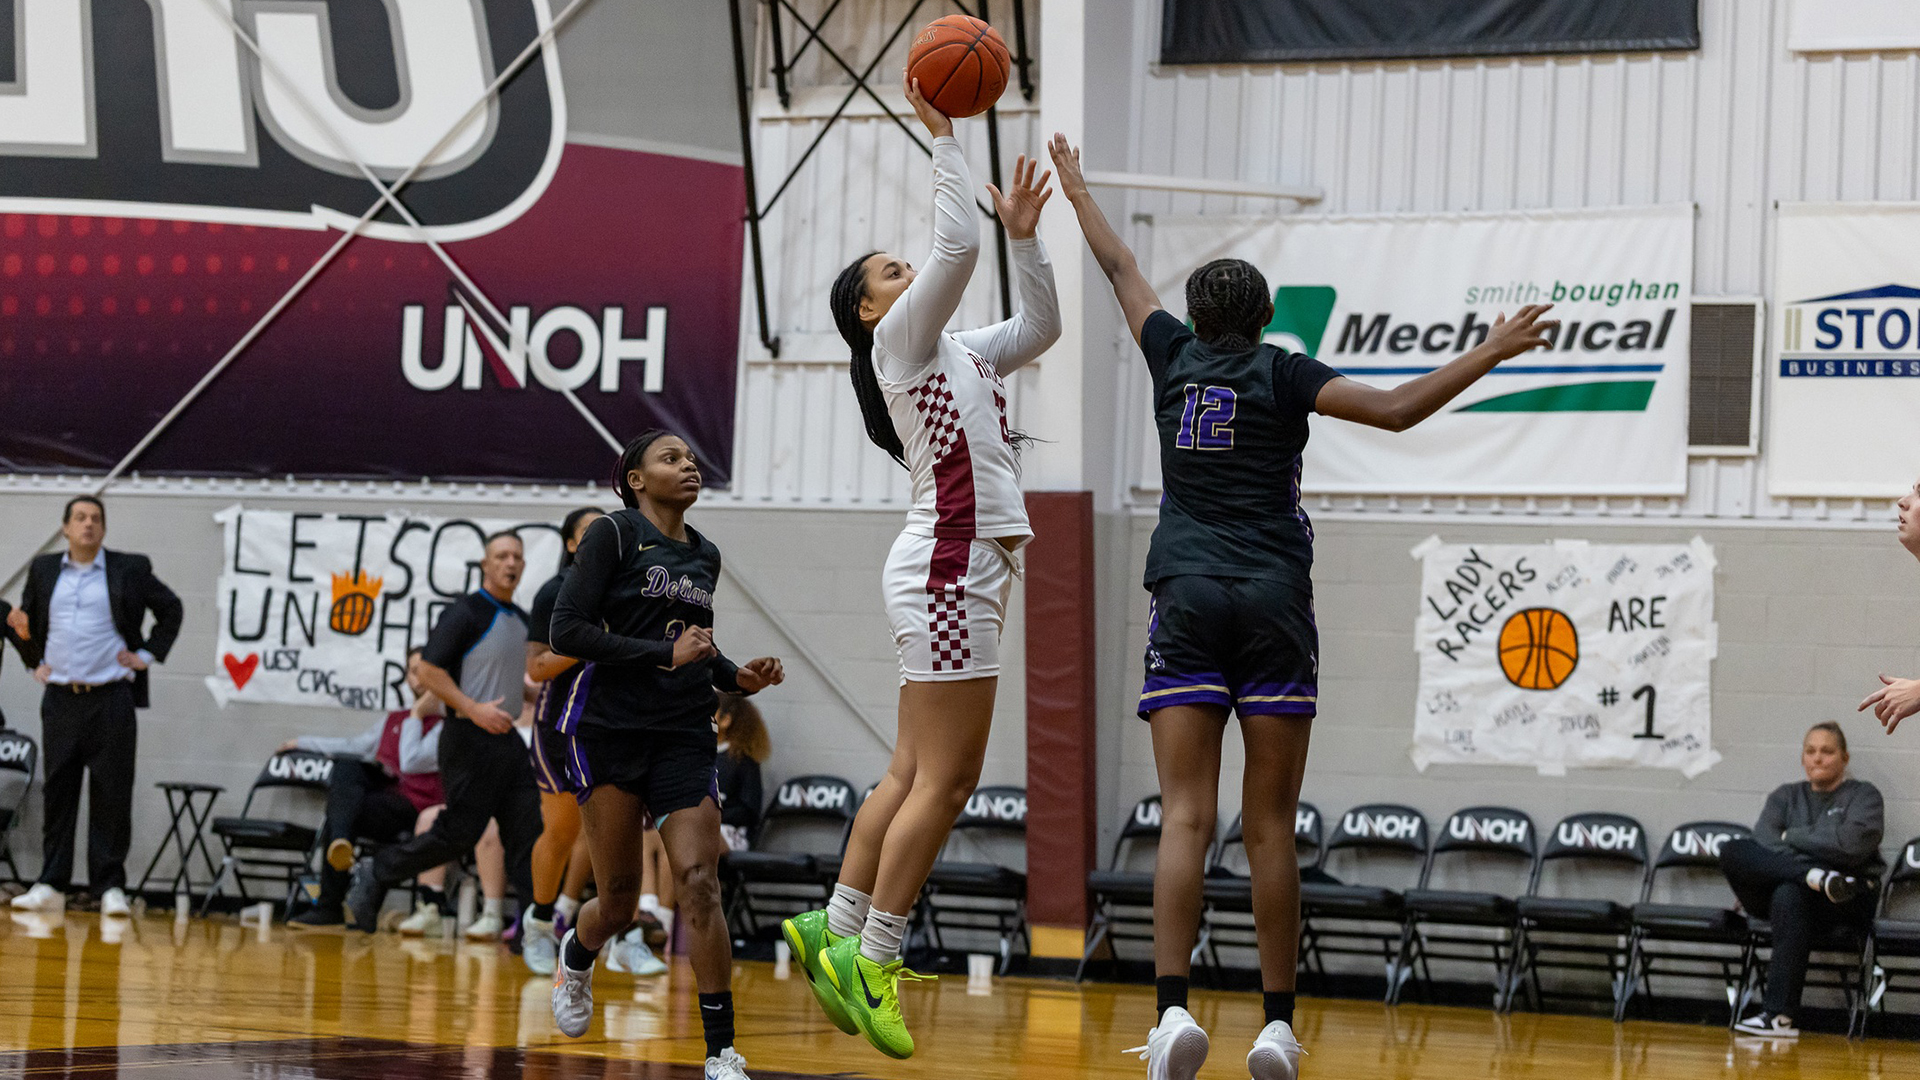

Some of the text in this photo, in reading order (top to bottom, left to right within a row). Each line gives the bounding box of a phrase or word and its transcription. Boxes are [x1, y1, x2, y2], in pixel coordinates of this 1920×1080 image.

[1464, 279, 1680, 307] smith-boughan
[1335, 308, 1677, 355] Mechnical
[1815, 308, 1920, 350] STO
[401, 304, 668, 392] UNOH
[1788, 361, 1920, 376] BUSINESS
[1175, 383, 1238, 450] 12
[1428, 548, 1493, 621] LADY
[1436, 557, 1537, 662] RACERS
[1608, 596, 1667, 633] ARE
[268, 756, 334, 781] UNOH
[777, 783, 850, 809] UNOH
[1343, 811, 1421, 839] UNOH
[1449, 814, 1529, 844] UNOH
[1557, 821, 1639, 850] UNOH
[1671, 829, 1741, 857] UNO
